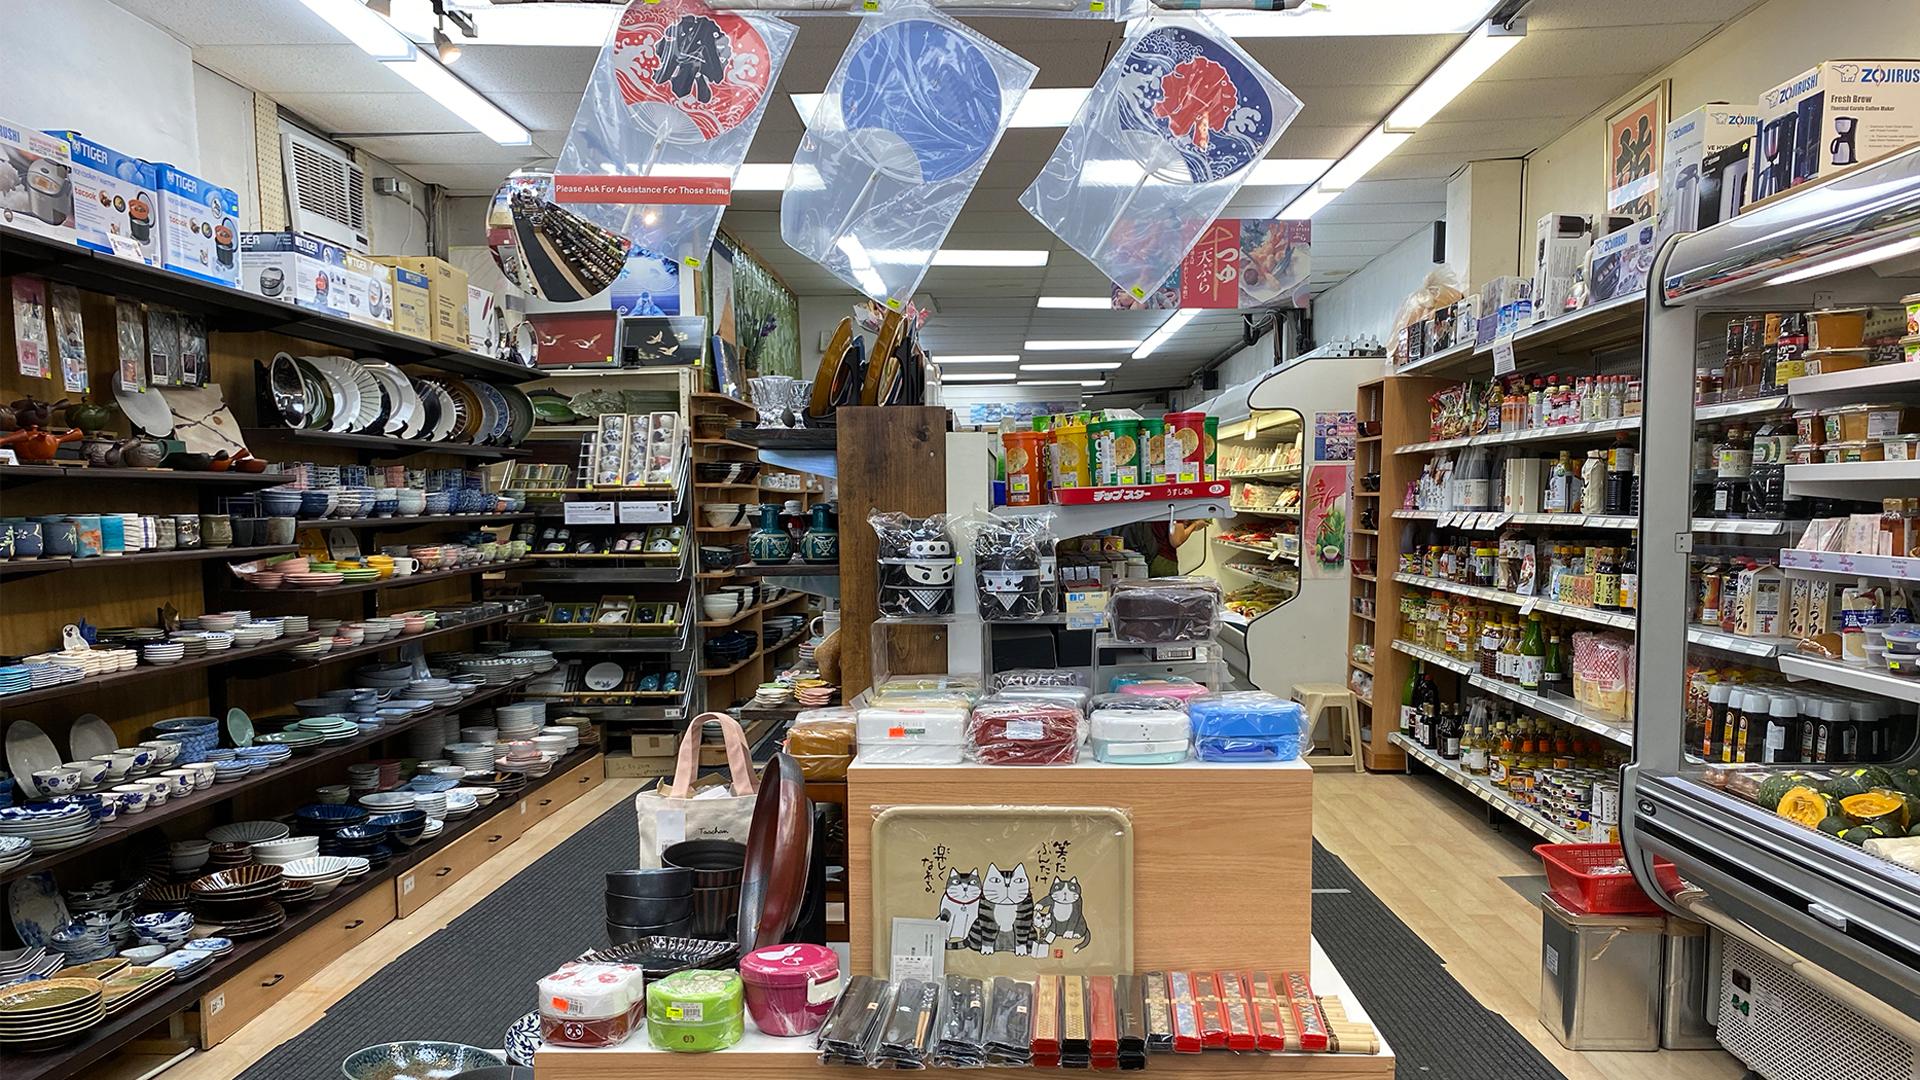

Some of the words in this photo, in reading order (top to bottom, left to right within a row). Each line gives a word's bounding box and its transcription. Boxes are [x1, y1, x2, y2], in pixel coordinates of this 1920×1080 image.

[1779, 74, 1819, 104] ZOJIRUSHI
[1830, 94, 1851, 103] Fresh
[1853, 94, 1873, 103] Brew
[80, 142, 108, 166] TIGER
[174, 172, 198, 194] TIGER
[555, 184, 583, 194] Please
[584, 185, 600, 194] Ask
[601, 185, 616, 194] For
[617, 185, 662, 195] Assistance
[662, 185, 677, 194] For
[678, 186, 704, 195] Those
[705, 186, 729, 196] Items
[1196, 247, 1214, 294] 天ぷら
[1216, 248, 1239, 284] つゆ
[1093, 490, 1151, 502] チップスター
[932, 844, 951, 882] 楽しく
[1034, 842, 1053, 885] ぶんだけ
[1053, 839, 1071, 874] 笑った
